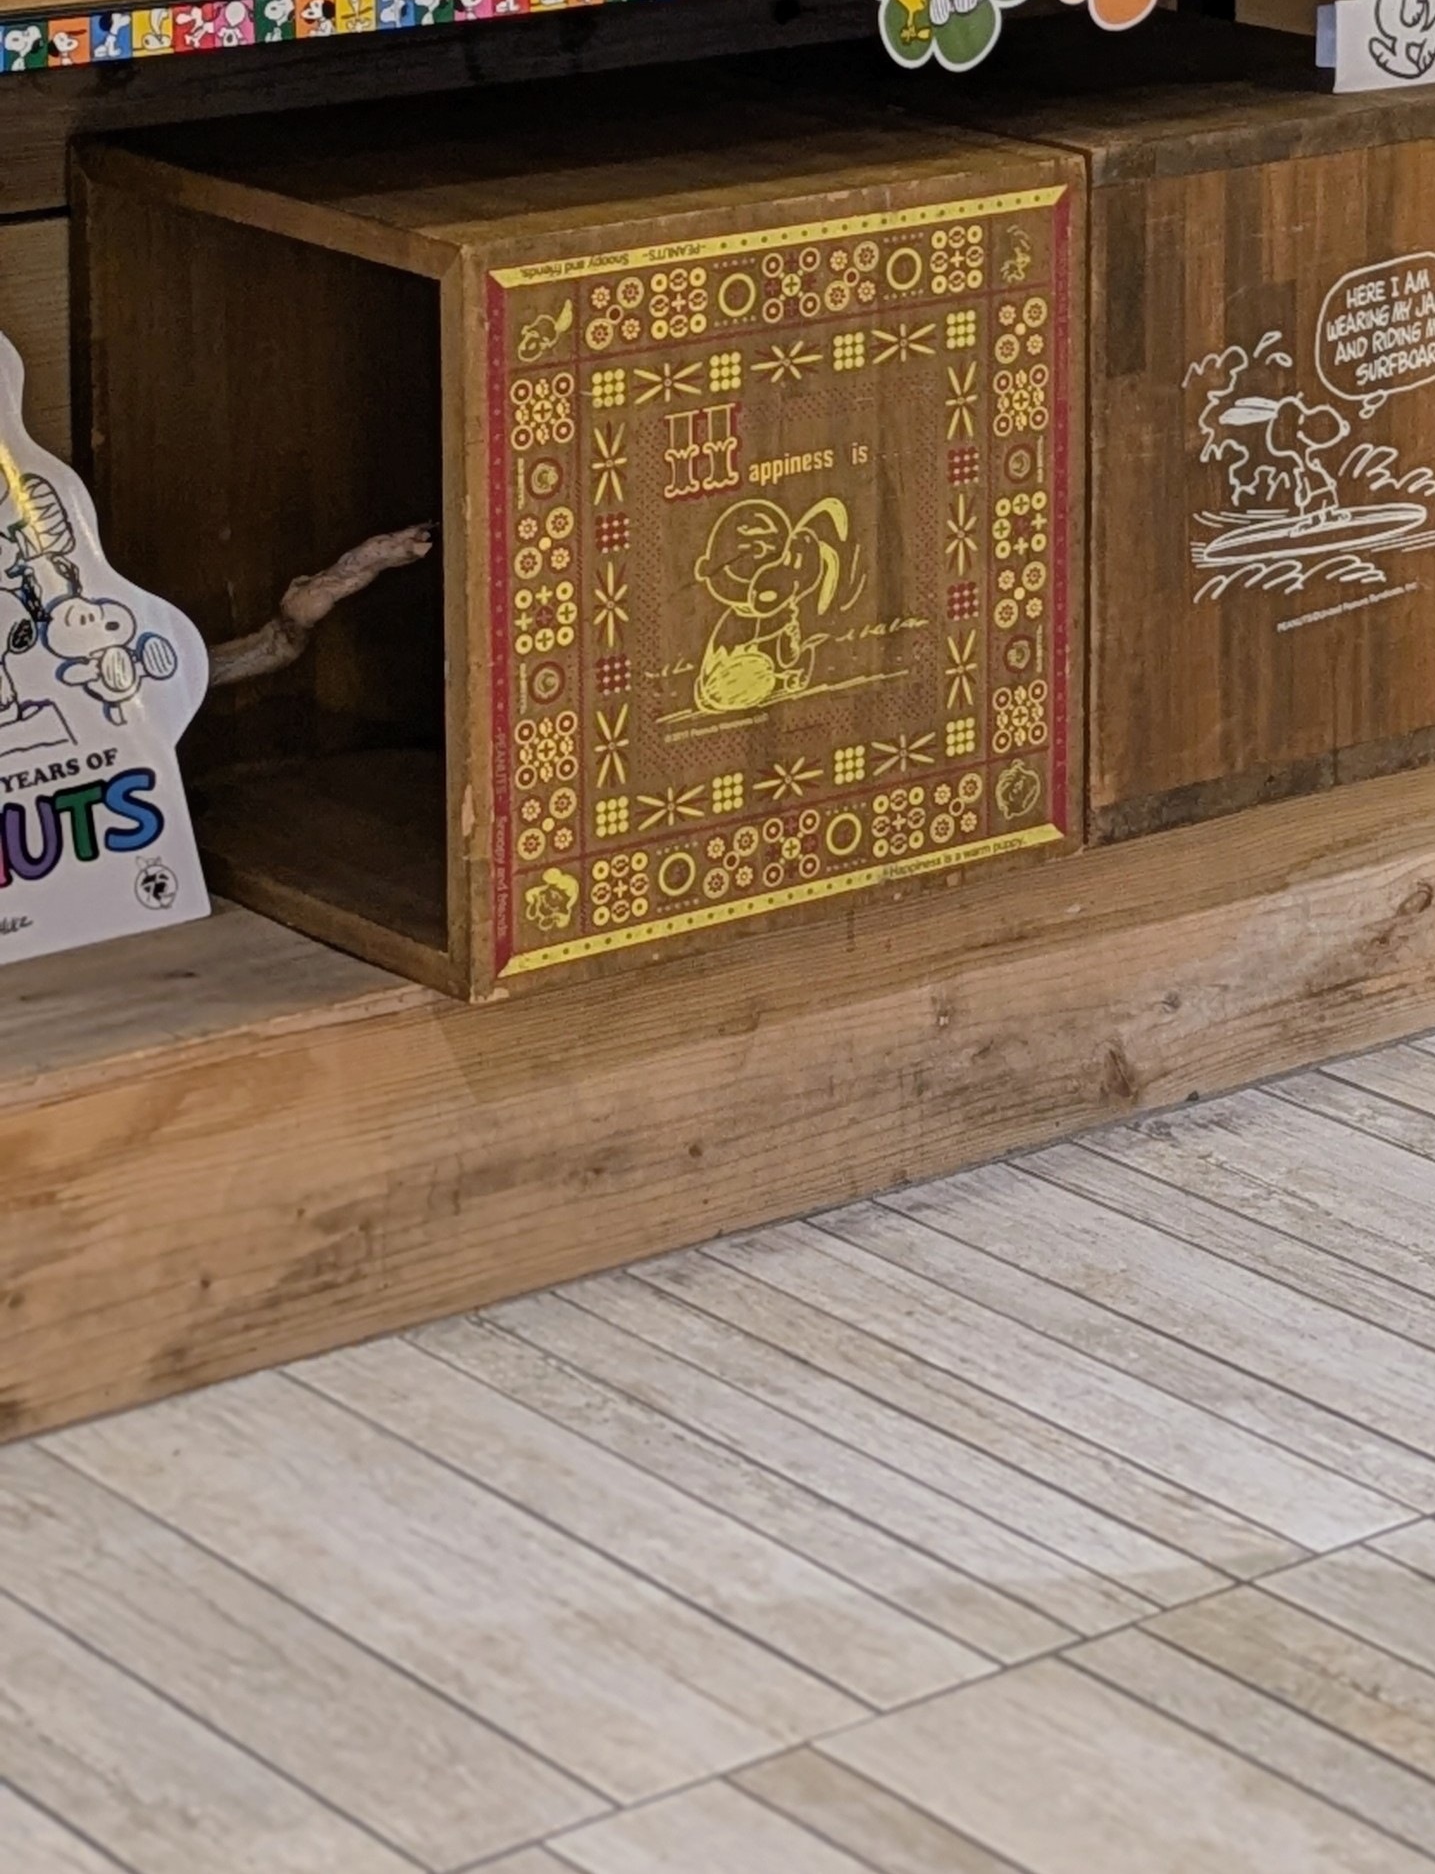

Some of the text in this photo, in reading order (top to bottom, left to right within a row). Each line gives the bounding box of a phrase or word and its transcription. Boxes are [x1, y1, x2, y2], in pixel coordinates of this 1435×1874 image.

[1346, 268, 1431, 309] HERE I AM
[1326, 304, 1390, 342] WEARING
[1391, 297, 1413, 323] MY
[1334, 336, 1369, 366] AND
[1371, 321, 1422, 354] RIDING
[851, 442, 868, 465] is
[1, 748, 118, 793] YEARS OF
[0, 767, 164, 888] UTS
